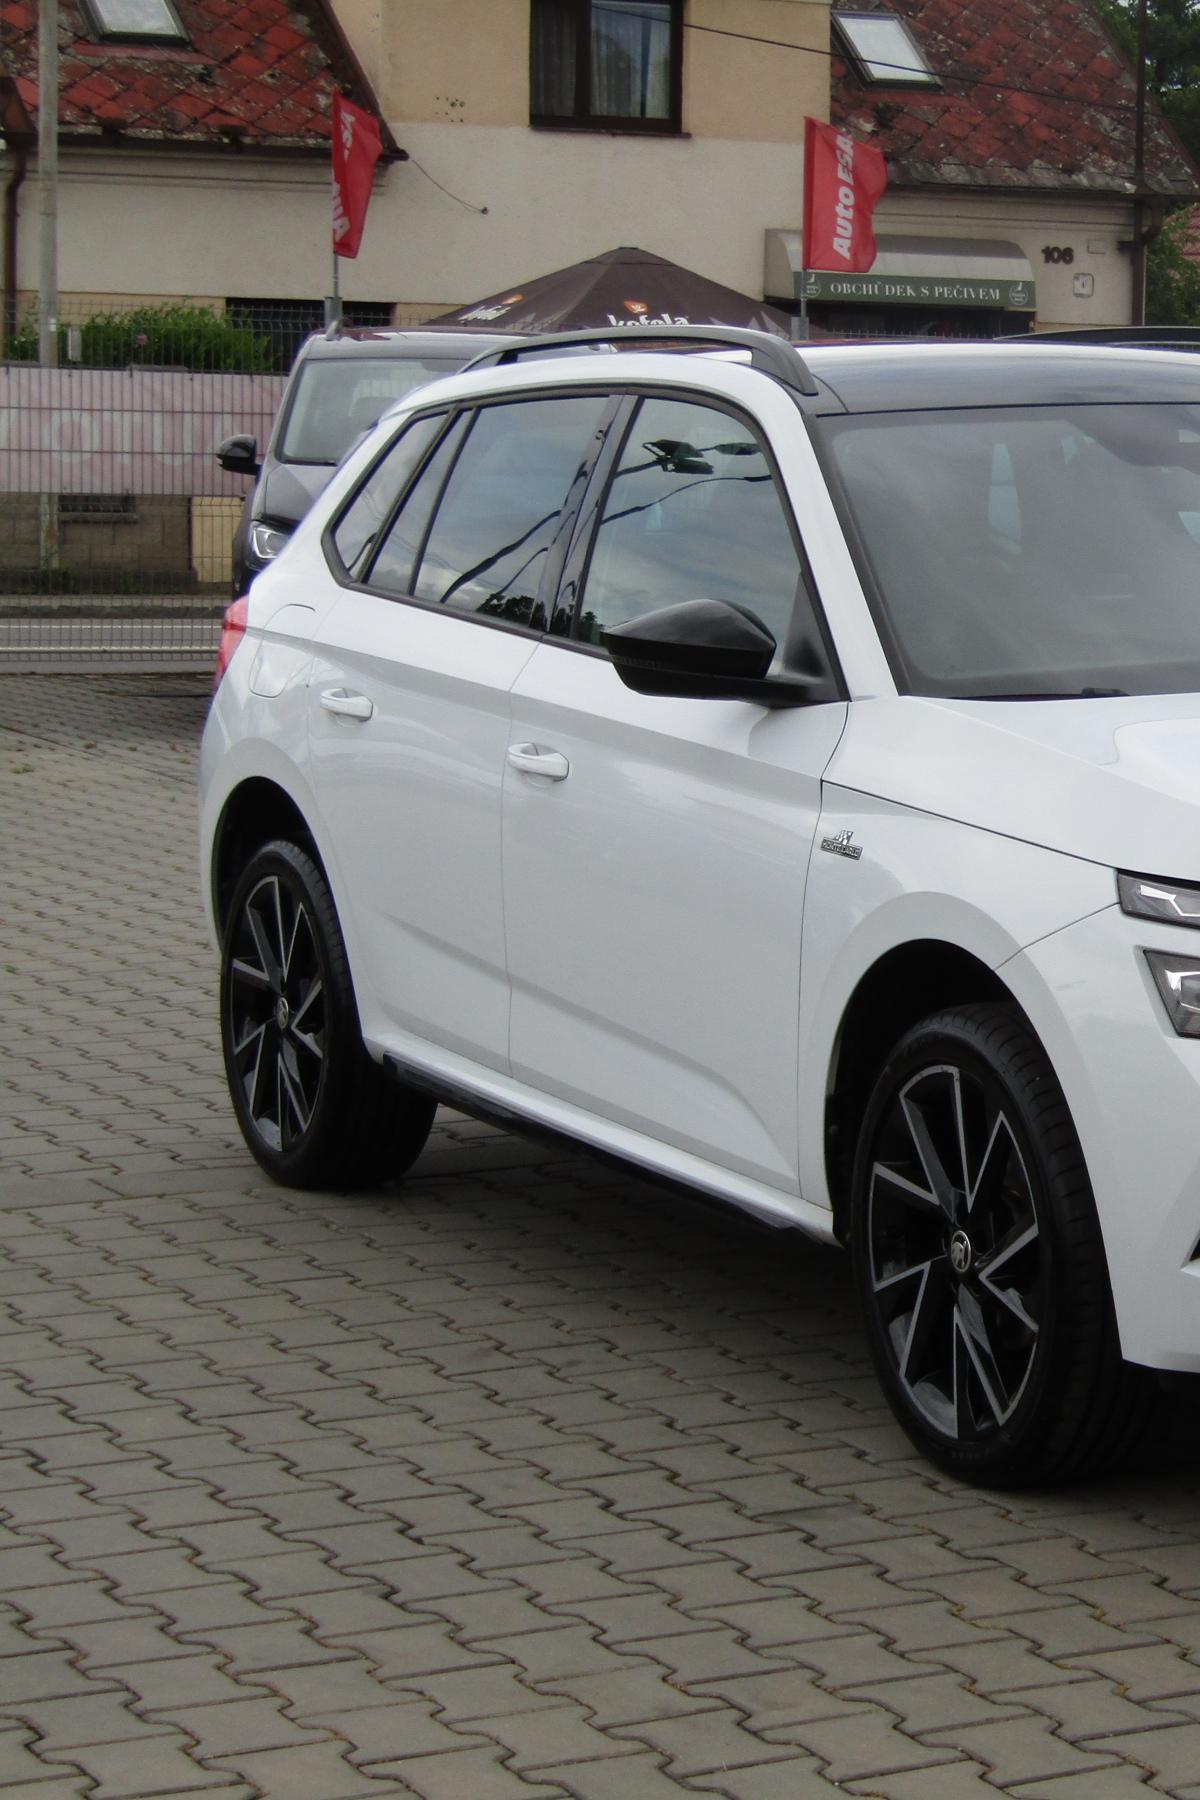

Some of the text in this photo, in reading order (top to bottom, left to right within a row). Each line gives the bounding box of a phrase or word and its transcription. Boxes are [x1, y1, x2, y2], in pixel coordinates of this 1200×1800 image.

[832, 134, 856, 261] Auto ESA
[830, 281, 917, 297] OBCHŮDEK
[920, 286, 930, 297] S
[934, 285, 1000, 300] PEČIVEM
